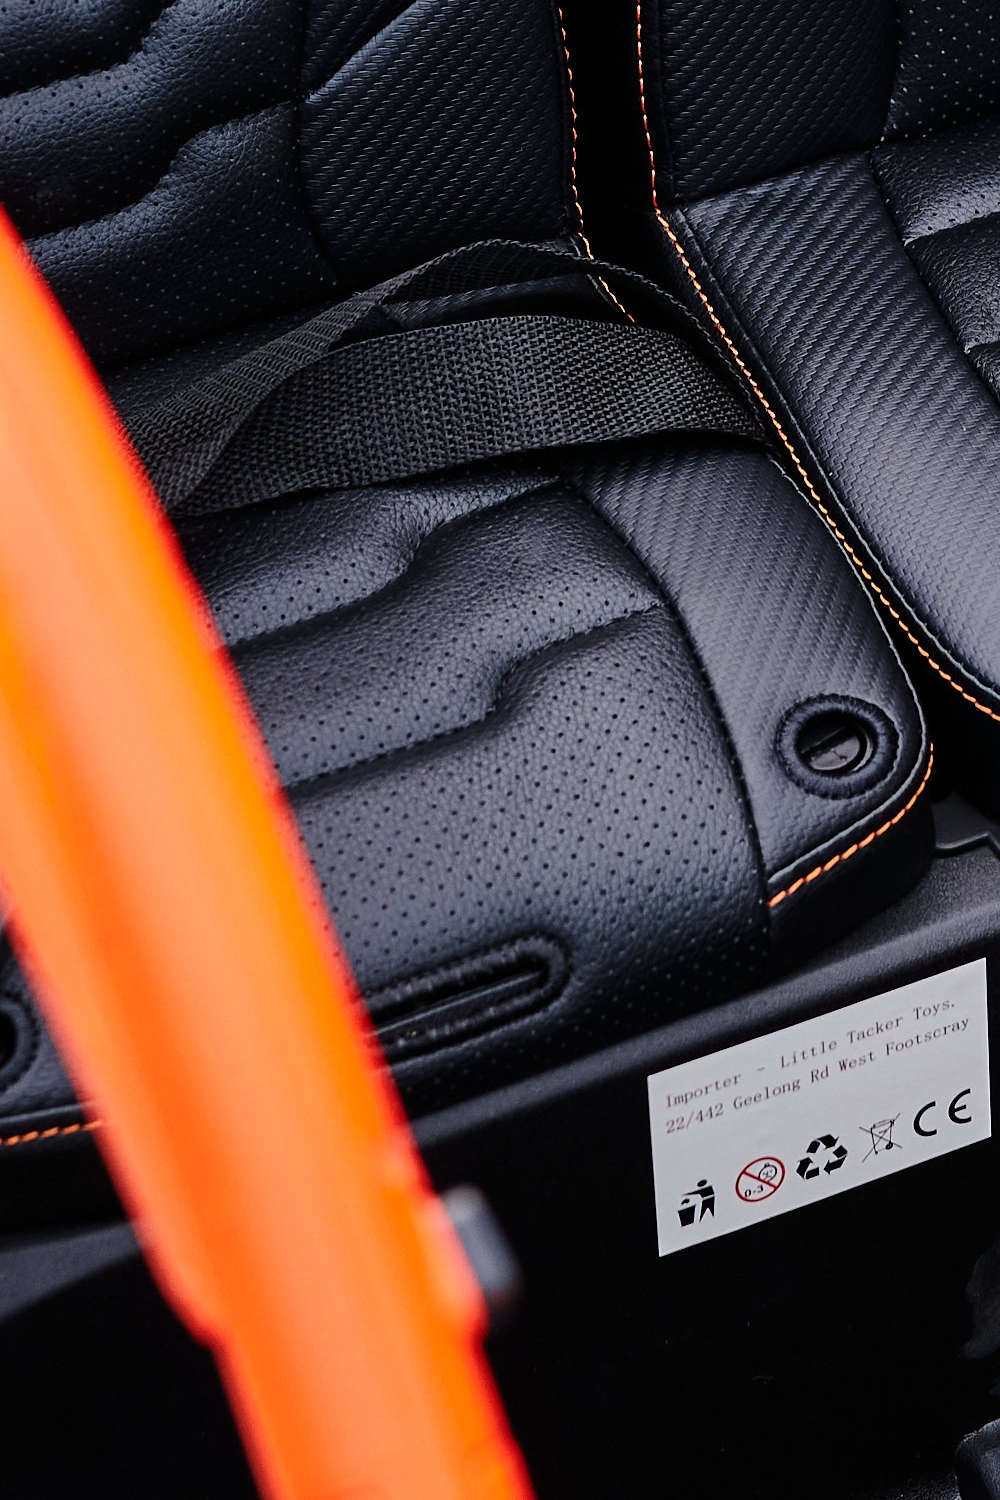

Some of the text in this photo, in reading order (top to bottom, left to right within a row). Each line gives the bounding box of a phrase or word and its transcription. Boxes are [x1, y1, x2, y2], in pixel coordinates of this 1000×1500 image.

[665, 1072, 742, 1108] Importer
[780, 1041, 837, 1069] Little
[846, 1017, 904, 1045] Tacker
[912, 998, 956, 1022] Toys.
[665, 1017, 970, 1134] 22/442 Geelong Rd West Footscray
[913, 1088, 973, 1137] CE
